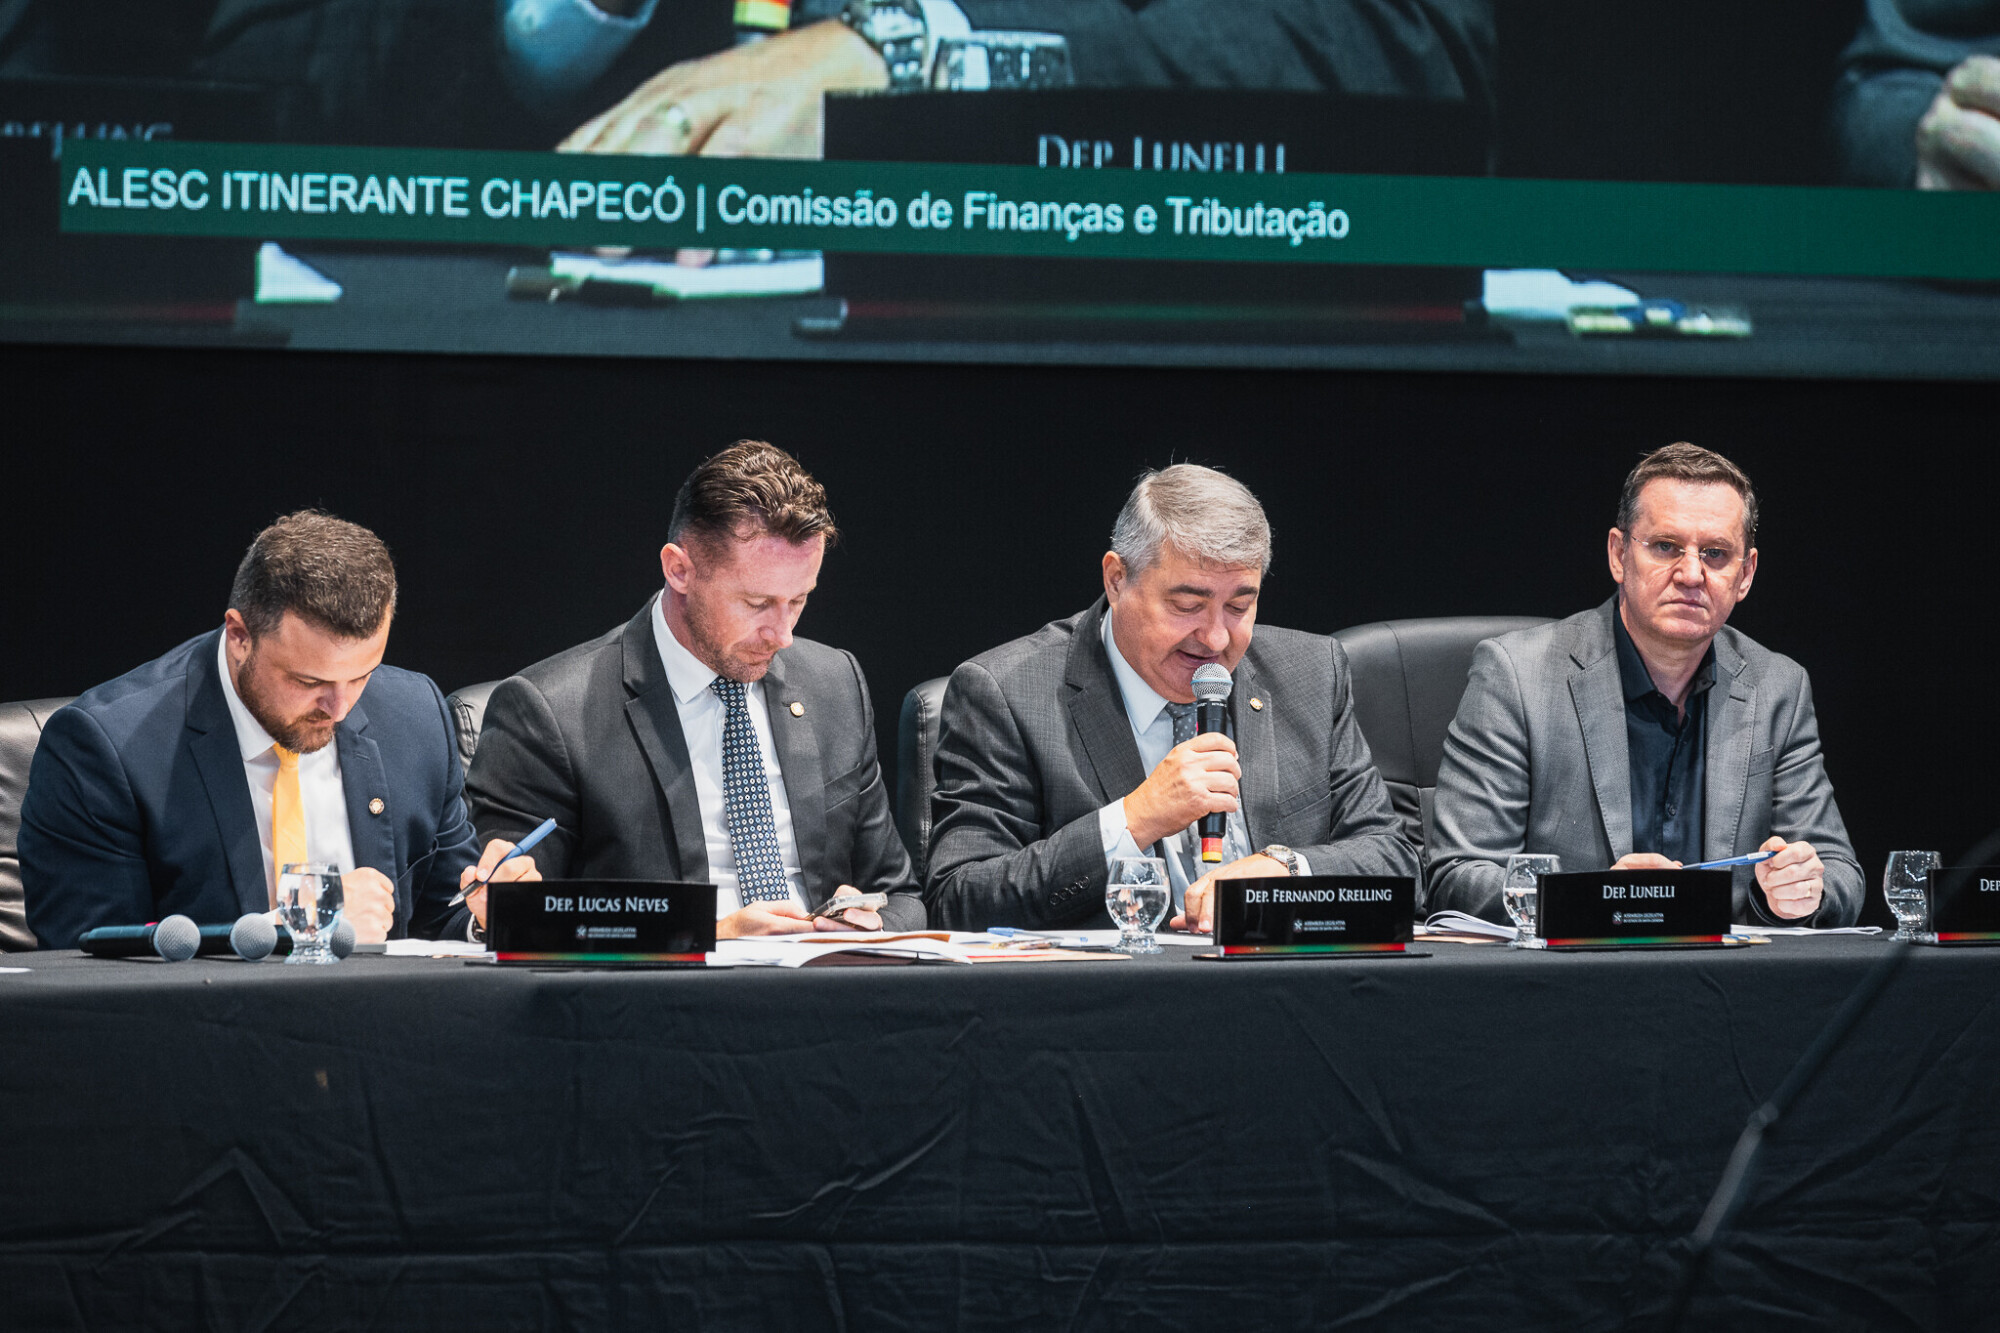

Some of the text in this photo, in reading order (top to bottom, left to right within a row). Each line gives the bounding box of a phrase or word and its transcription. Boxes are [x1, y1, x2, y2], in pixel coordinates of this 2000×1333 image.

[68, 167, 209, 210] ALESC
[222, 171, 470, 217] ITINERANTE
[480, 175, 686, 223] CHAPECÓ
[717, 184, 899, 229] Comissão
[906, 190, 953, 230] de
[963, 191, 1125, 242] Finanças
[1133, 205, 1158, 234] e
[1166, 195, 1350, 247] Tributação
[1272, 888, 1336, 903] FERNANDO
[1338, 887, 1393, 902] KRELLING
[1629, 884, 1675, 899] LUNELLI
[578, 895, 622, 912] LUCAS
[625, 896, 669, 913] NEVES
